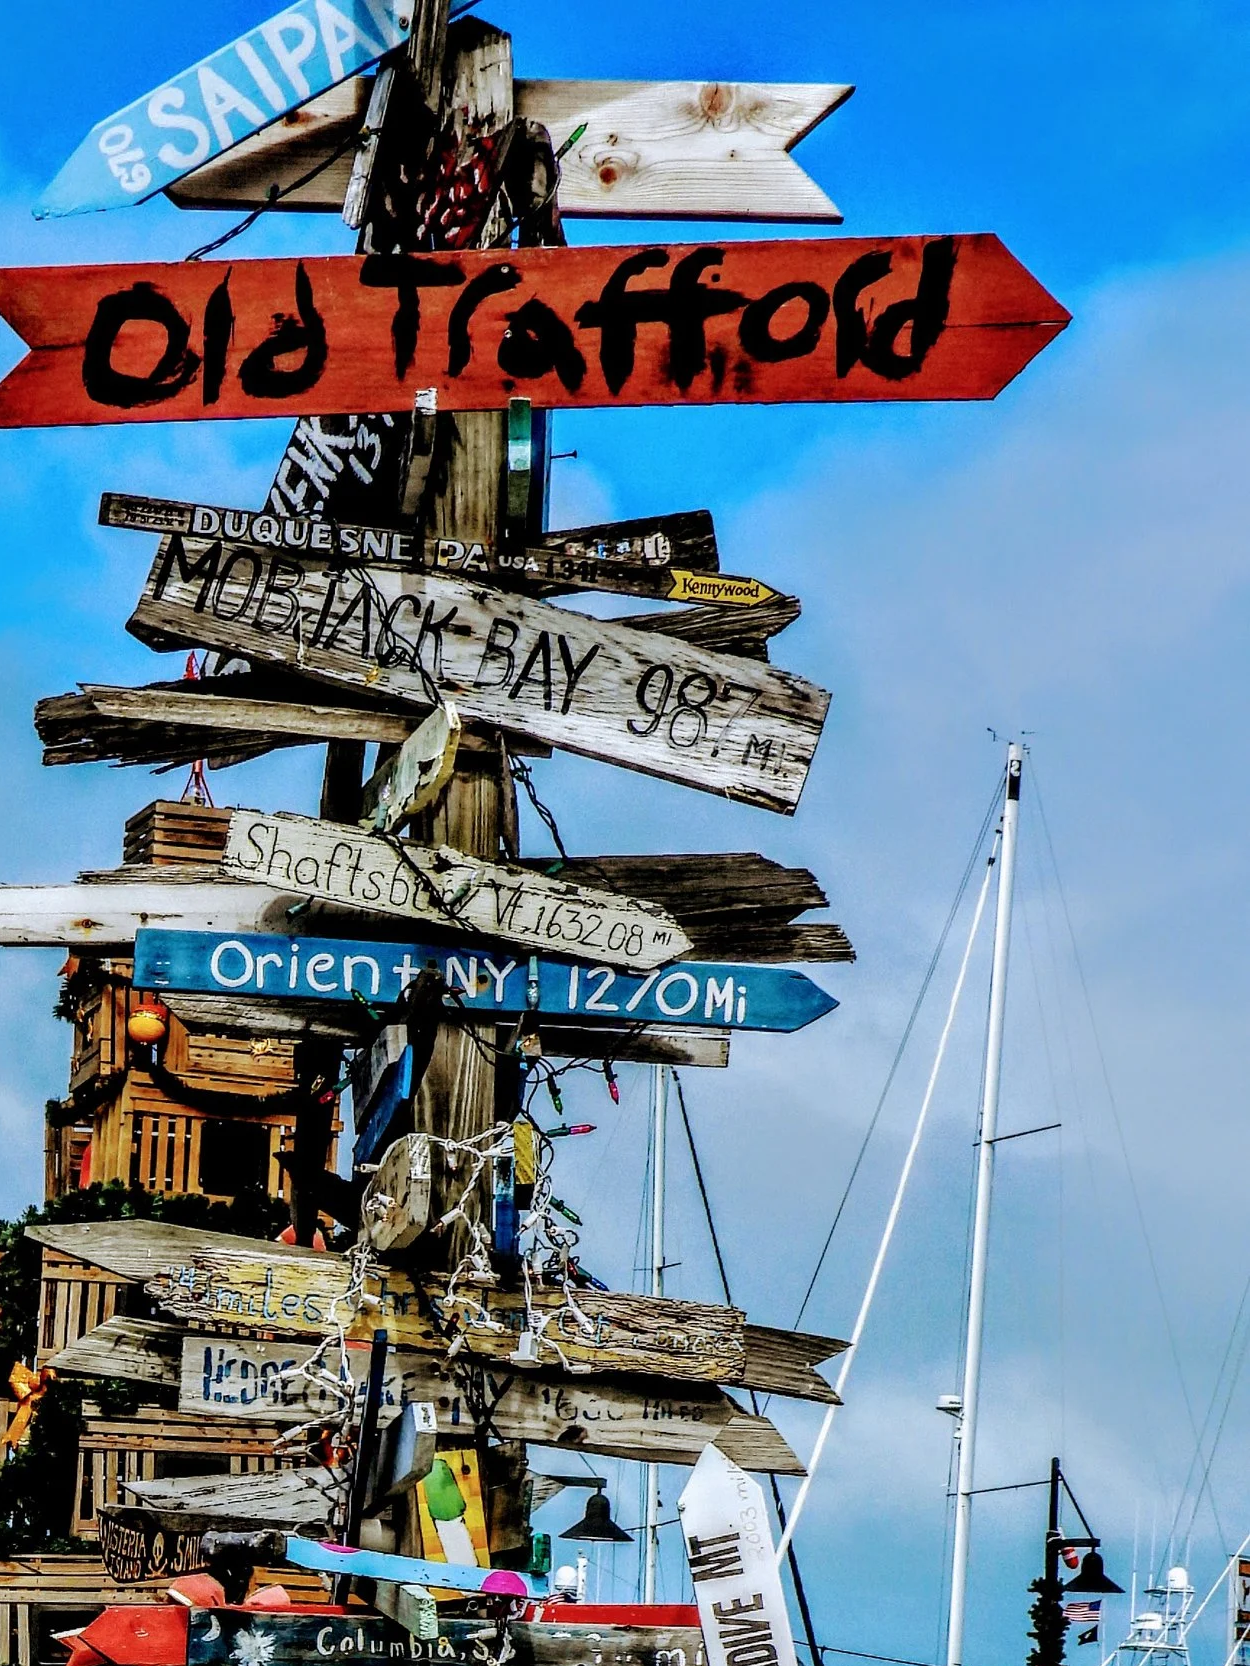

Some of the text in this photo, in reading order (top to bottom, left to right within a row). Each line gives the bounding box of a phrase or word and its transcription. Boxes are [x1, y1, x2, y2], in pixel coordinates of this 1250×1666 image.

[81, 234, 964, 408] Old Trafford
[435, 539, 490, 572] PA
[499, 555, 539, 572] USA
[681, 576, 760, 599] Kennywood
[152, 533, 458, 682] MOBJACK
[473, 618, 601, 715] BAY
[626, 663, 764, 758] 987
[688, 1532, 745, 1582] MT
